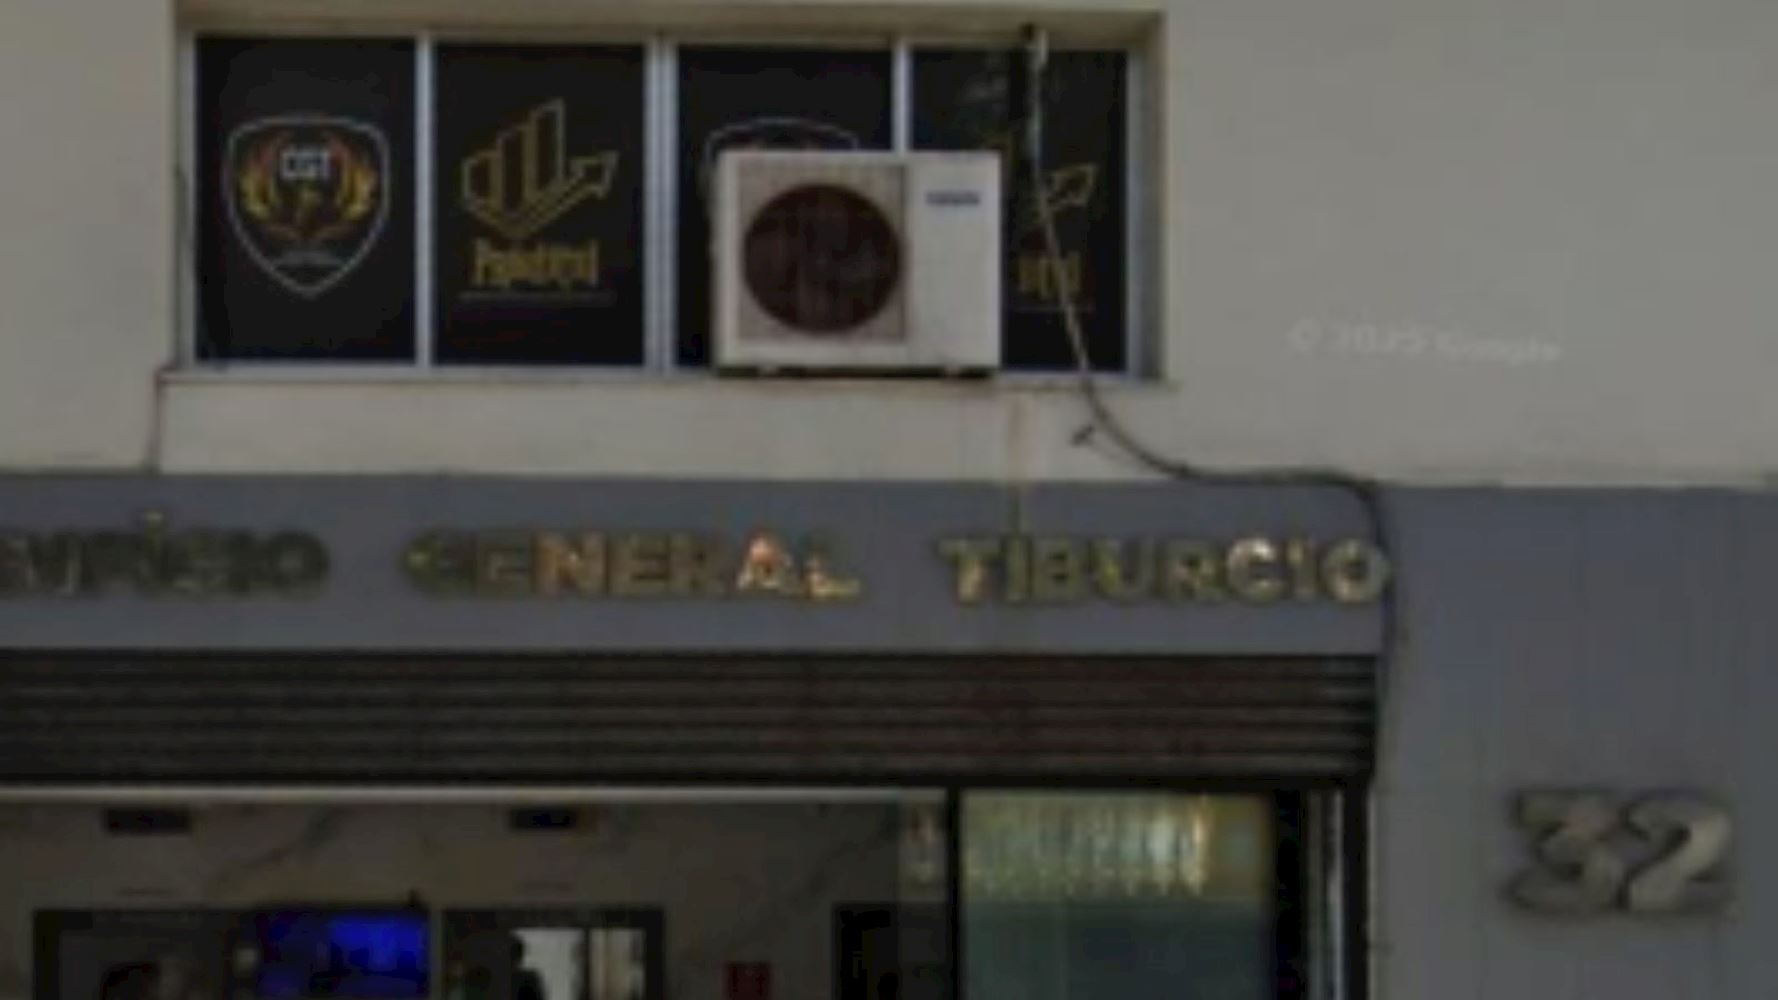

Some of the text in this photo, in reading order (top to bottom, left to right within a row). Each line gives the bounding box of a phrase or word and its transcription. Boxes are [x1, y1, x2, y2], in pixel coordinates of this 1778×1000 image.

[404, 530, 862, 602] GENERAL
[938, 535, 1390, 602] TIBURCIO
[1508, 788, 1734, 914] 32
